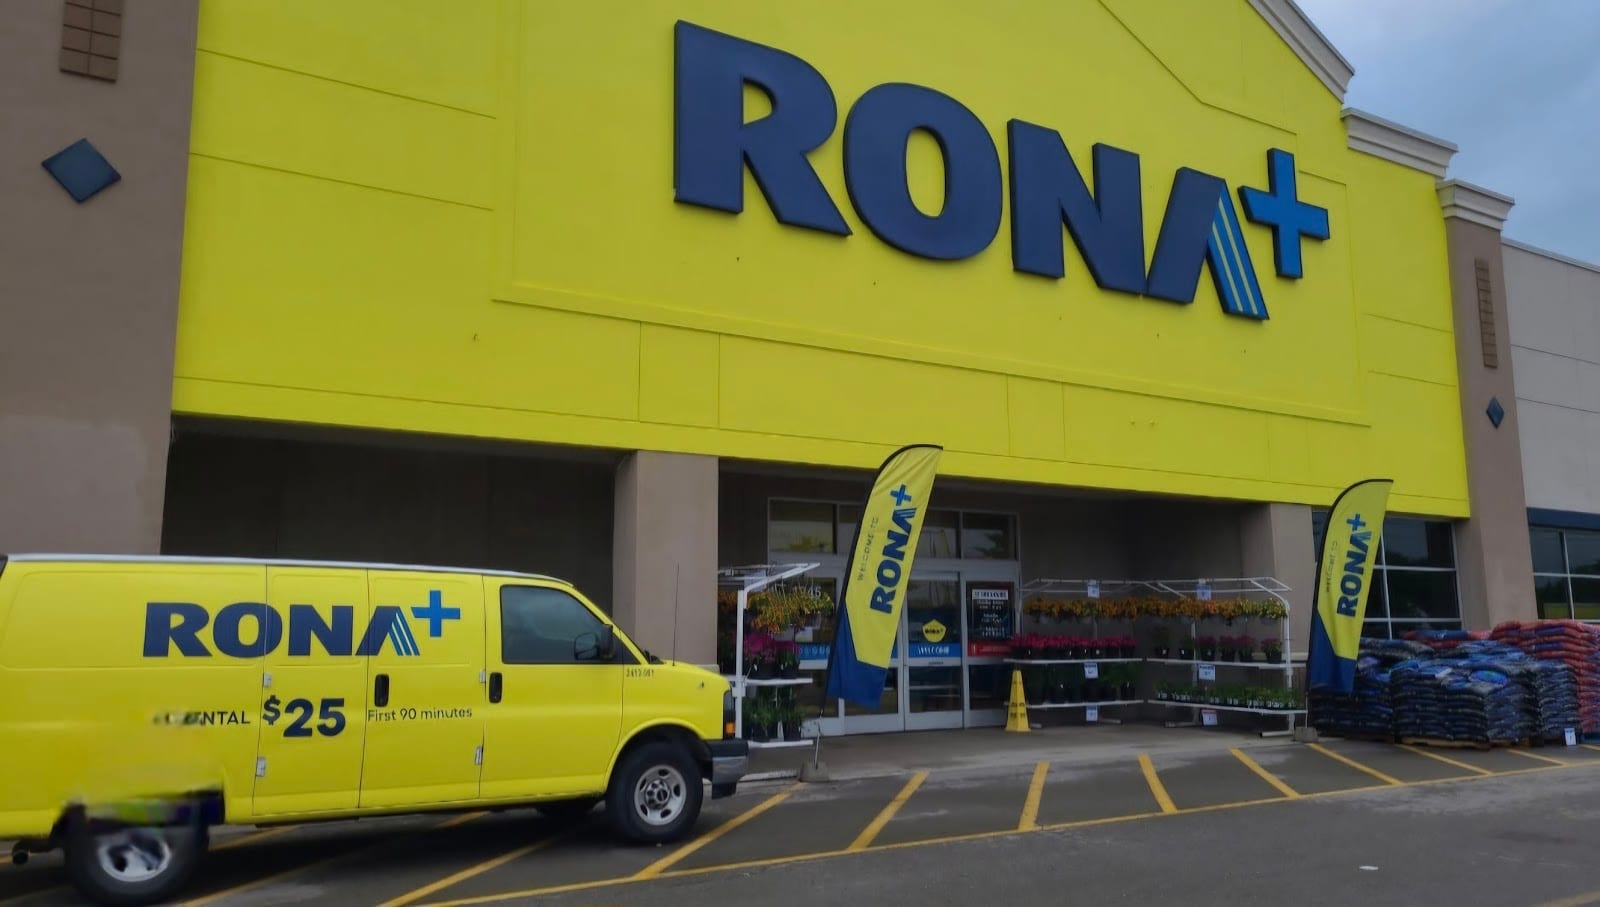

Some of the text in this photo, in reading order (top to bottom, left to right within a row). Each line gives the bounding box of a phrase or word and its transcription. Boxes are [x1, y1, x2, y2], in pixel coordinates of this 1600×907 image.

[262, 694, 346, 738] $25
[367, 709, 397, 722] First
[399, 707, 417, 720] 90
[420, 706, 473, 720] minutes
